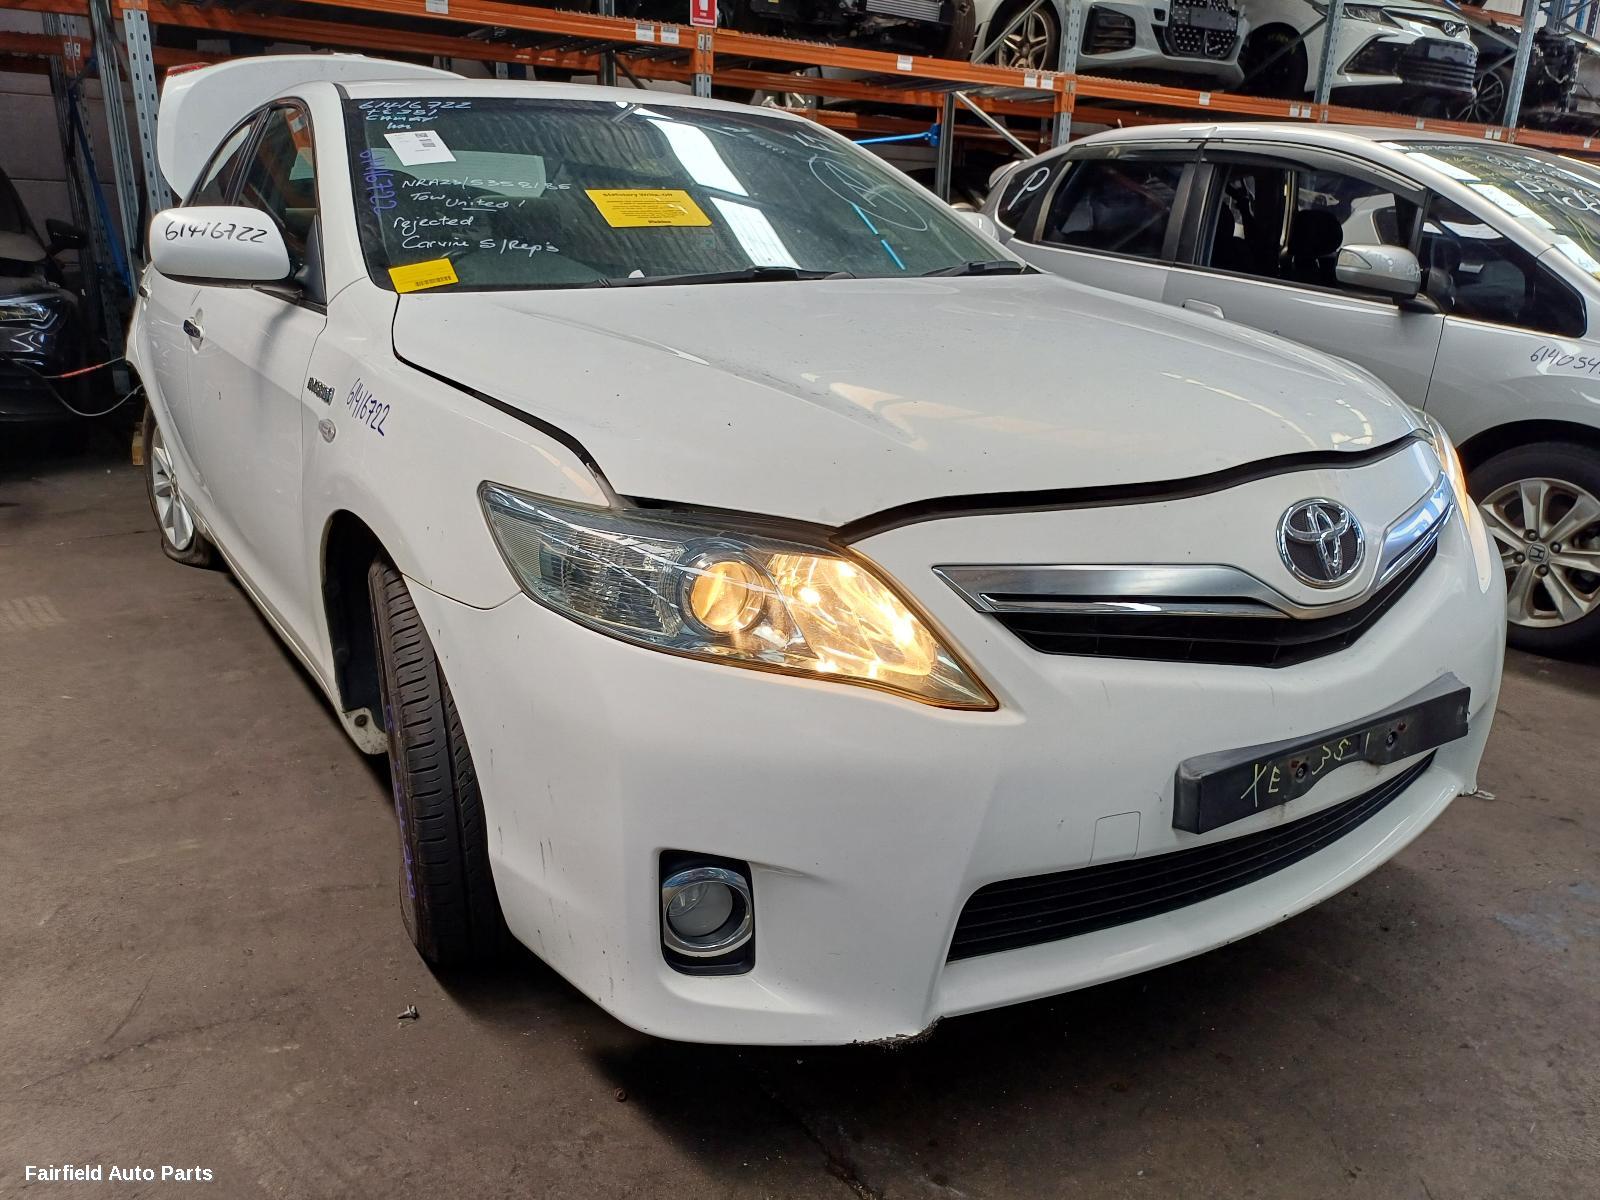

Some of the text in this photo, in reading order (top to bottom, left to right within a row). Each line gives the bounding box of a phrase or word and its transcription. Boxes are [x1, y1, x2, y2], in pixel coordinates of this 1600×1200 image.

[358, 100, 472, 110] 61416722
[445, 196, 509, 208] United
[164, 220, 268, 244] 61416722
[393, 215, 475, 237] rejected
[1530, 345, 1600, 374] 614054
